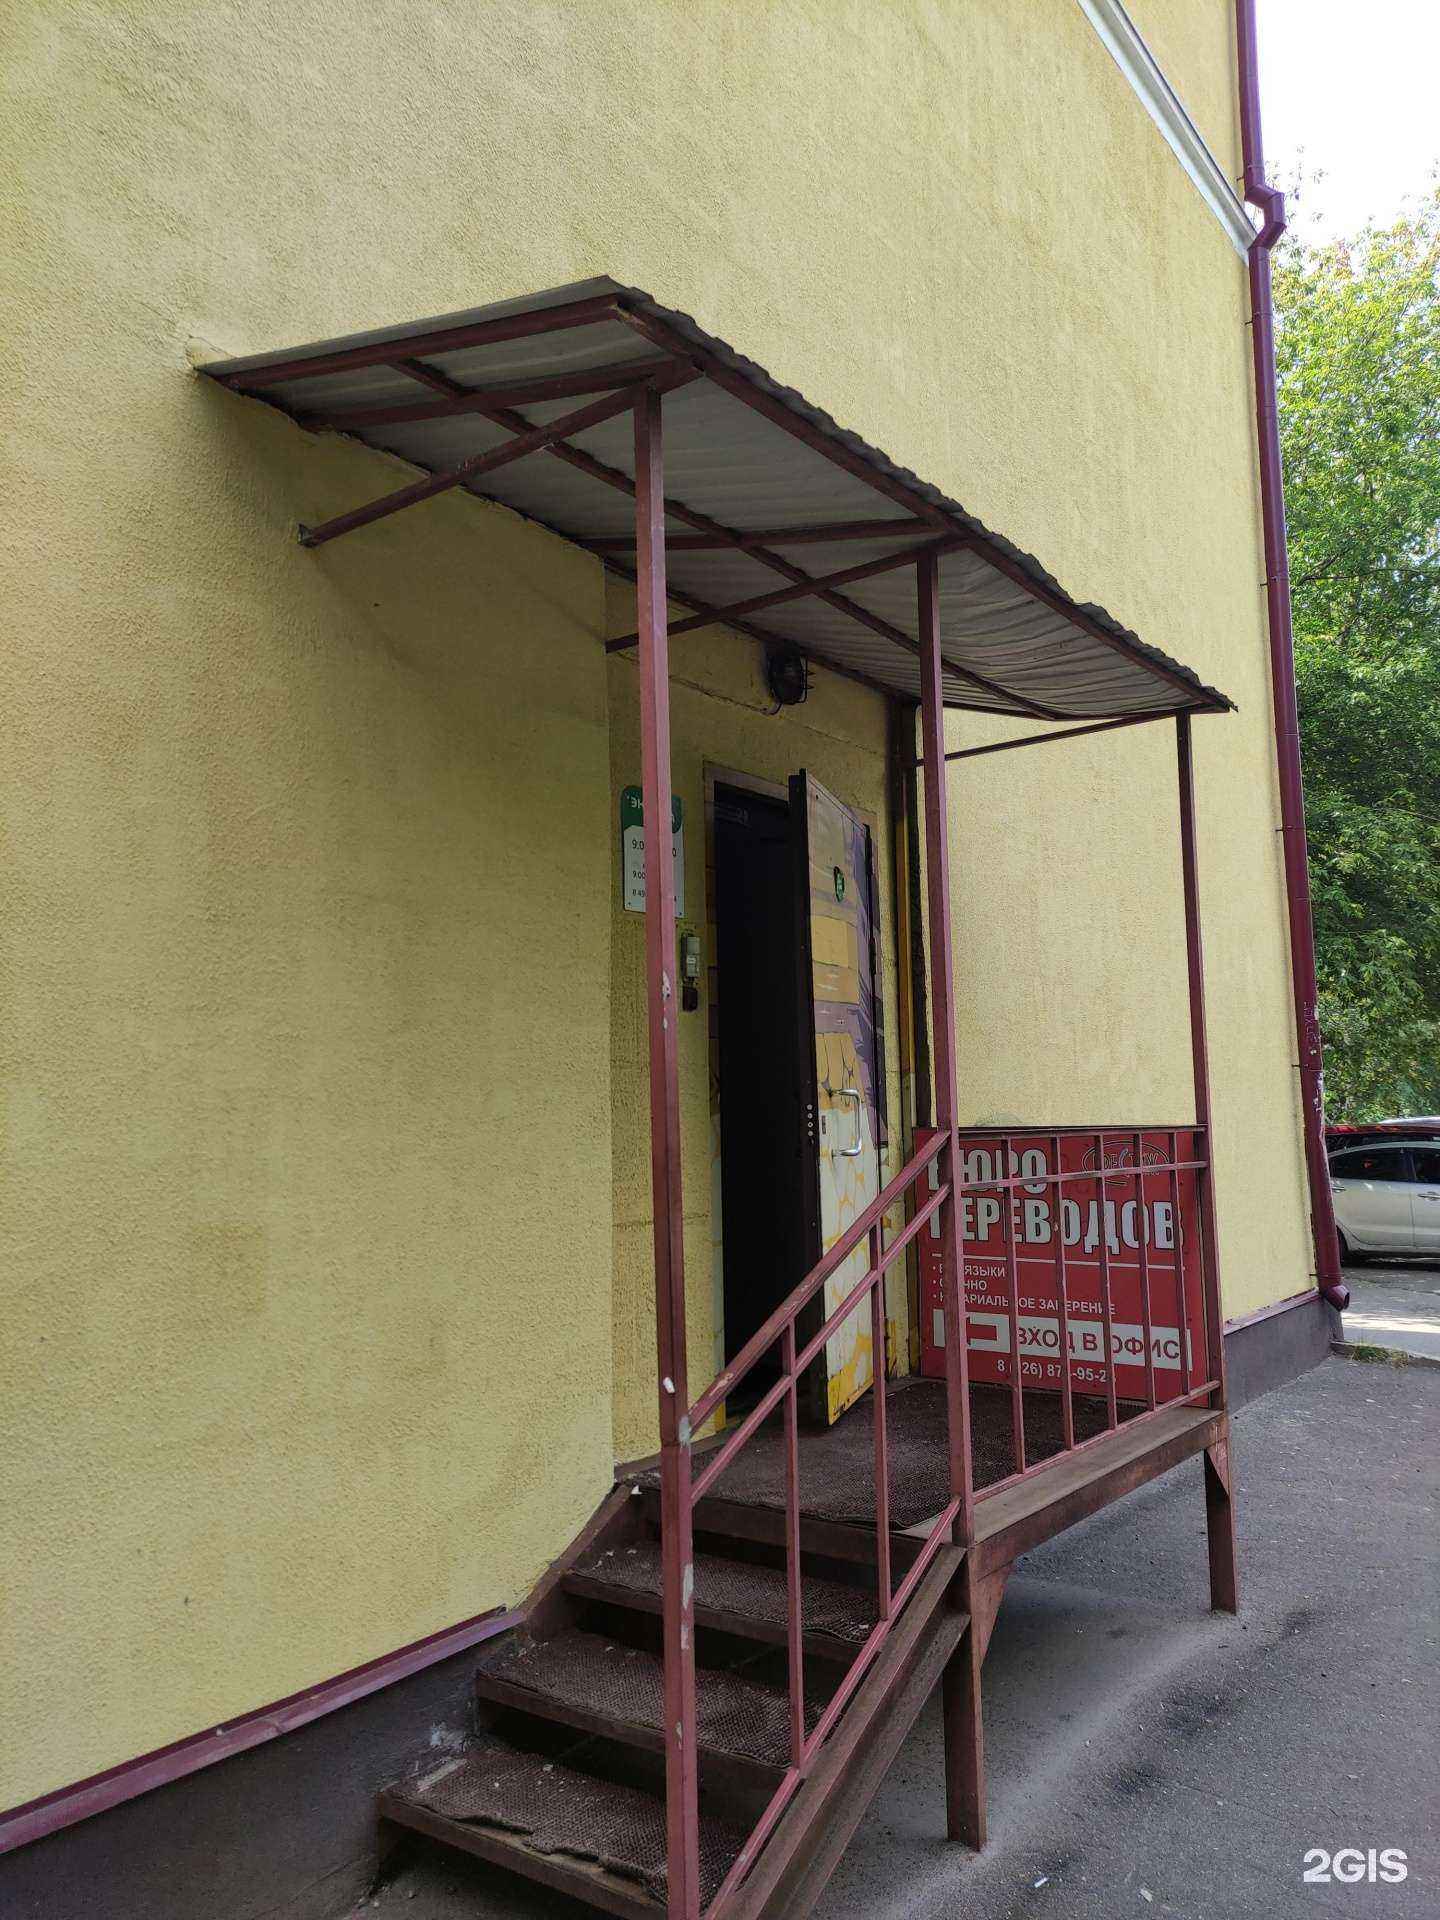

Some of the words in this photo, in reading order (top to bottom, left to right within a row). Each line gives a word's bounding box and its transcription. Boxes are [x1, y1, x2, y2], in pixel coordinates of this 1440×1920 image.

[964, 1265, 1006, 1278] ЯЗЫКИ
[1083, 1332, 1099, 1352] В
[1009, 1361, 1044, 1379] (26)
[1047, 1363, 1116, 1384] 87-95-2
